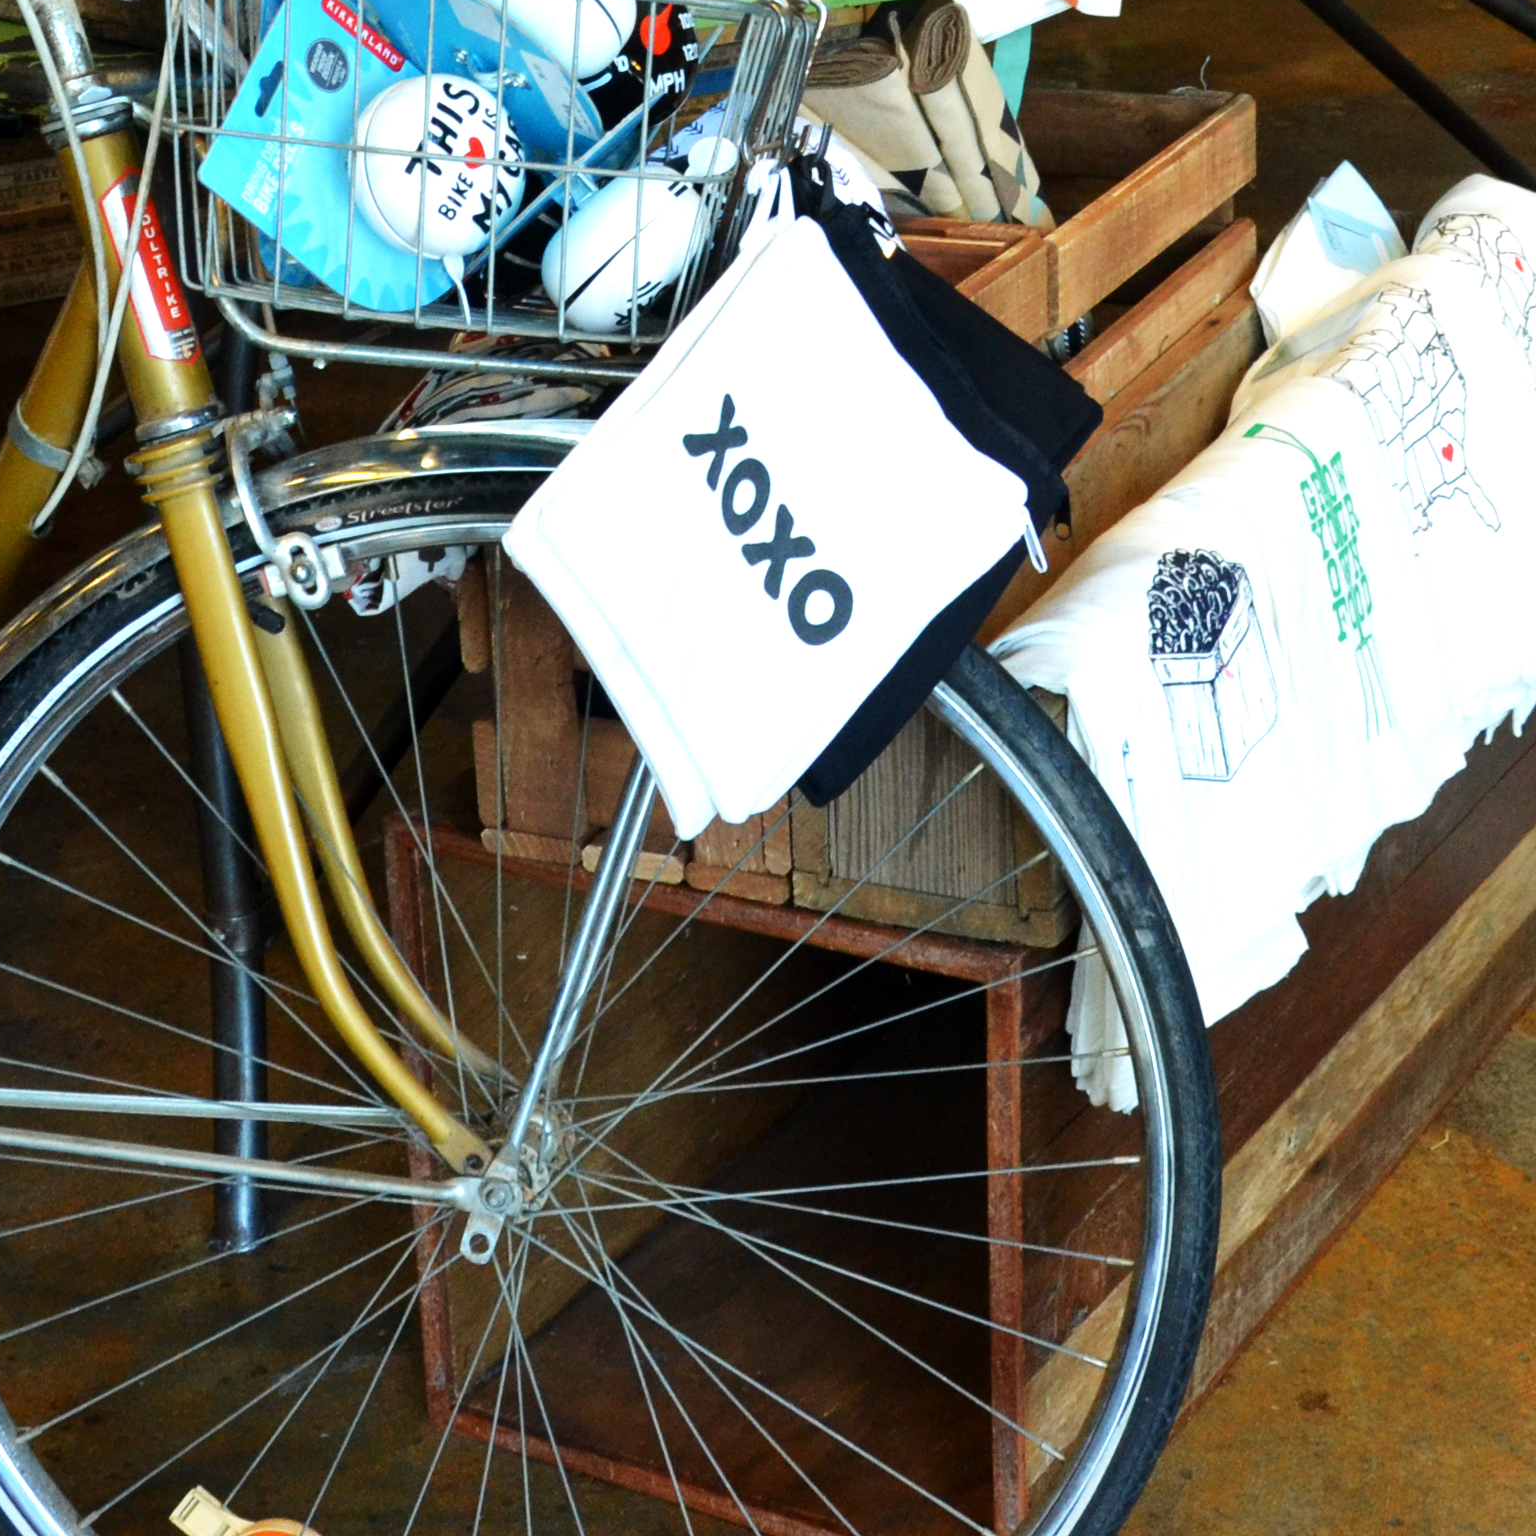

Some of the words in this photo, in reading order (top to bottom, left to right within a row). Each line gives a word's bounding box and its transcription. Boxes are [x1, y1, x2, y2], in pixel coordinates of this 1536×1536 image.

[648, 68, 686, 98] MPH
[404, 81, 480, 178] THIS
[437, 171, 475, 221] BIKE
[140, 210, 182, 319] DULTRIKE
[346, 498, 455, 525] Streetster
[681, 392, 855, 647] XOXO
[1299, 450, 1348, 521] GROW
[1310, 492, 1361, 561] YOUR
